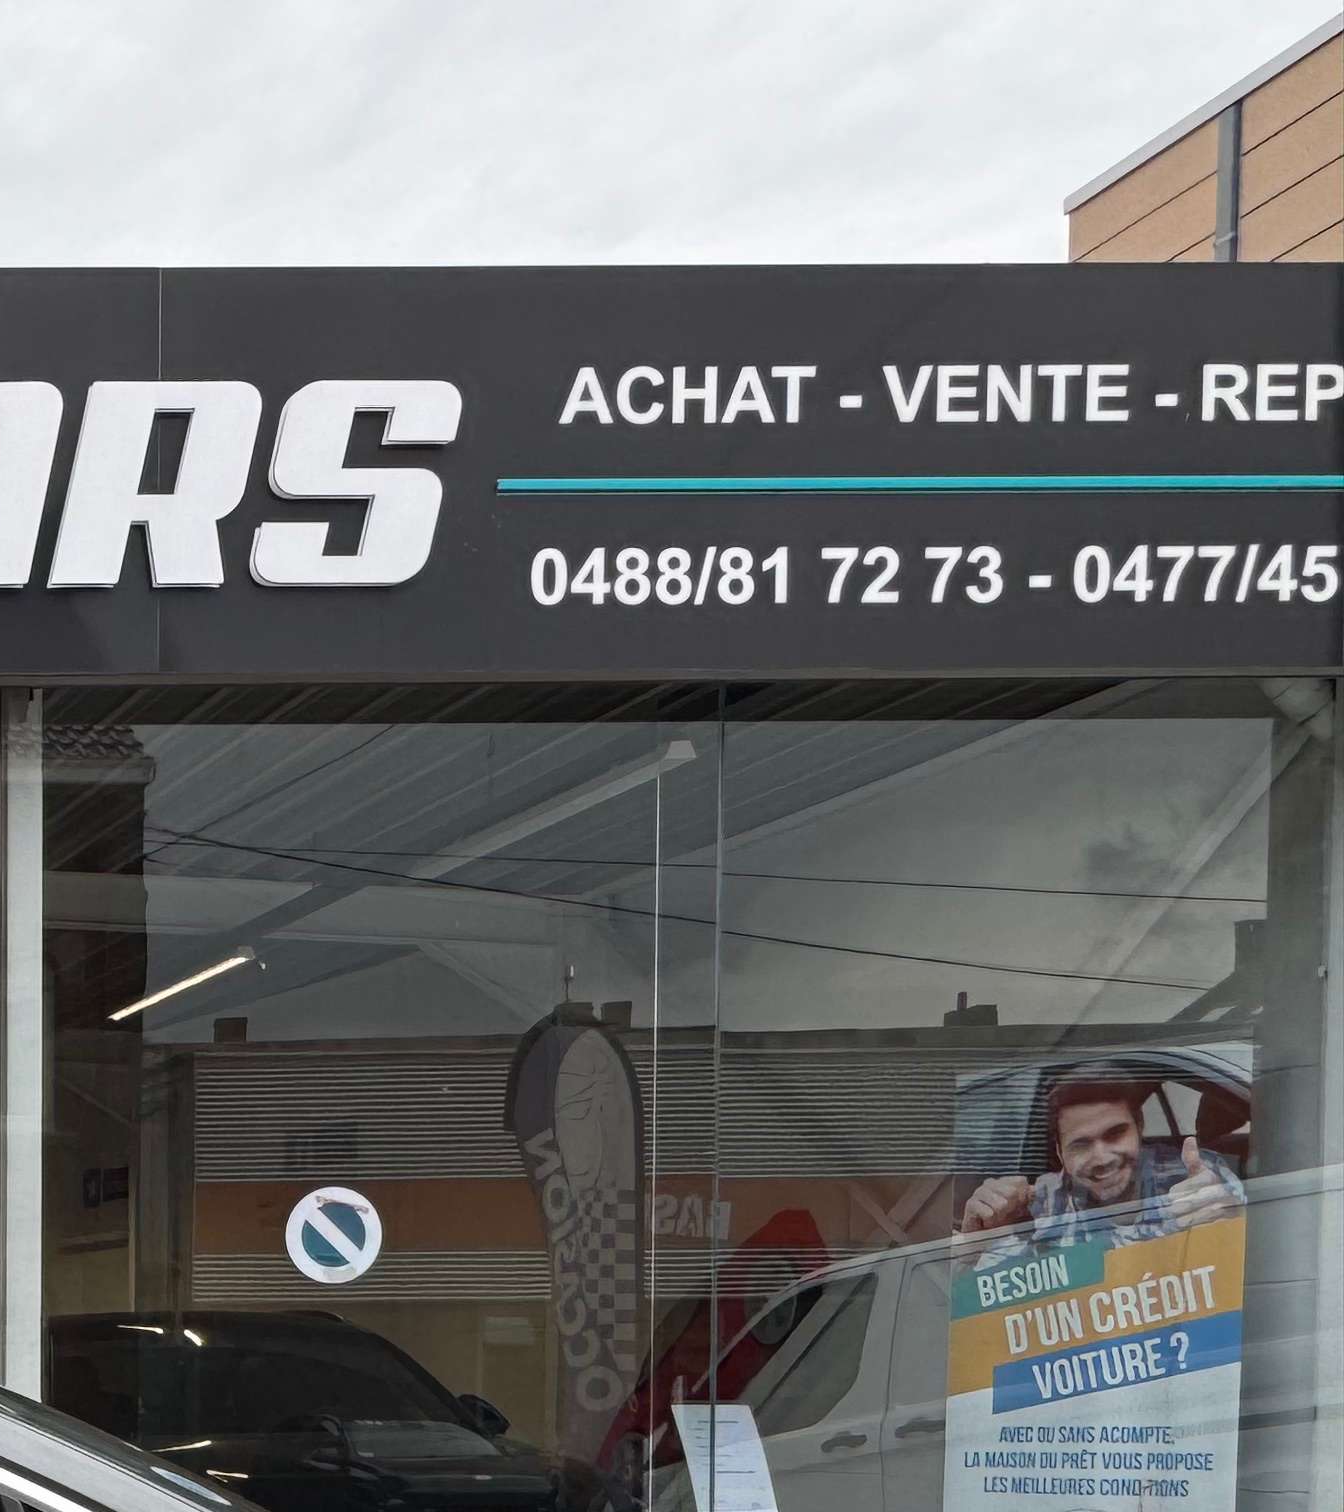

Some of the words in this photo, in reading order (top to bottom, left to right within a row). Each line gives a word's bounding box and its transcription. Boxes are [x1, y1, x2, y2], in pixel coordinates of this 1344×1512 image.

[558, 364, 817, 425] ACHAT
[839, 393, 863, 409] -
[882, 363, 1130, 423] VENTE
[1154, 392, 1179, 407] -
[1201, 363, 1344, 422] REP
[530, 545, 789, 606] 0488/81
[821, 545, 900, 604] 72
[924, 545, 1004, 604] 73
[1028, 574, 1053, 589] -
[1073, 543, 1340, 604] 0477/45
[976, 1254, 1070, 1308] BESOIN
[1004, 1298, 1084, 1354] D'UN
[1089, 1265, 1216, 1334] CRÉDIT
[1032, 1337, 1166, 1399] VOITURE
[1169, 1332, 1190, 1370] ?
[964, 1451, 981, 1468] LA
[985, 1451, 1036, 1469] MAISON
[1040, 1452, 1058, 1469] DU
[1061, 1449, 1097, 1470] PRÊT
[1102, 1452, 1143, 1471] VOUS
[1146, 1453, 1214, 1472] PROPOSE
[999, 1426, 1033, 1444] AVEC
[1037, 1426, 1055, 1444] OU
[1058, 1426, 1095, 1445] SANS
[984, 1476, 1008, 1494] LES
[1011, 1477, 1096, 1496] MEILLEURES
